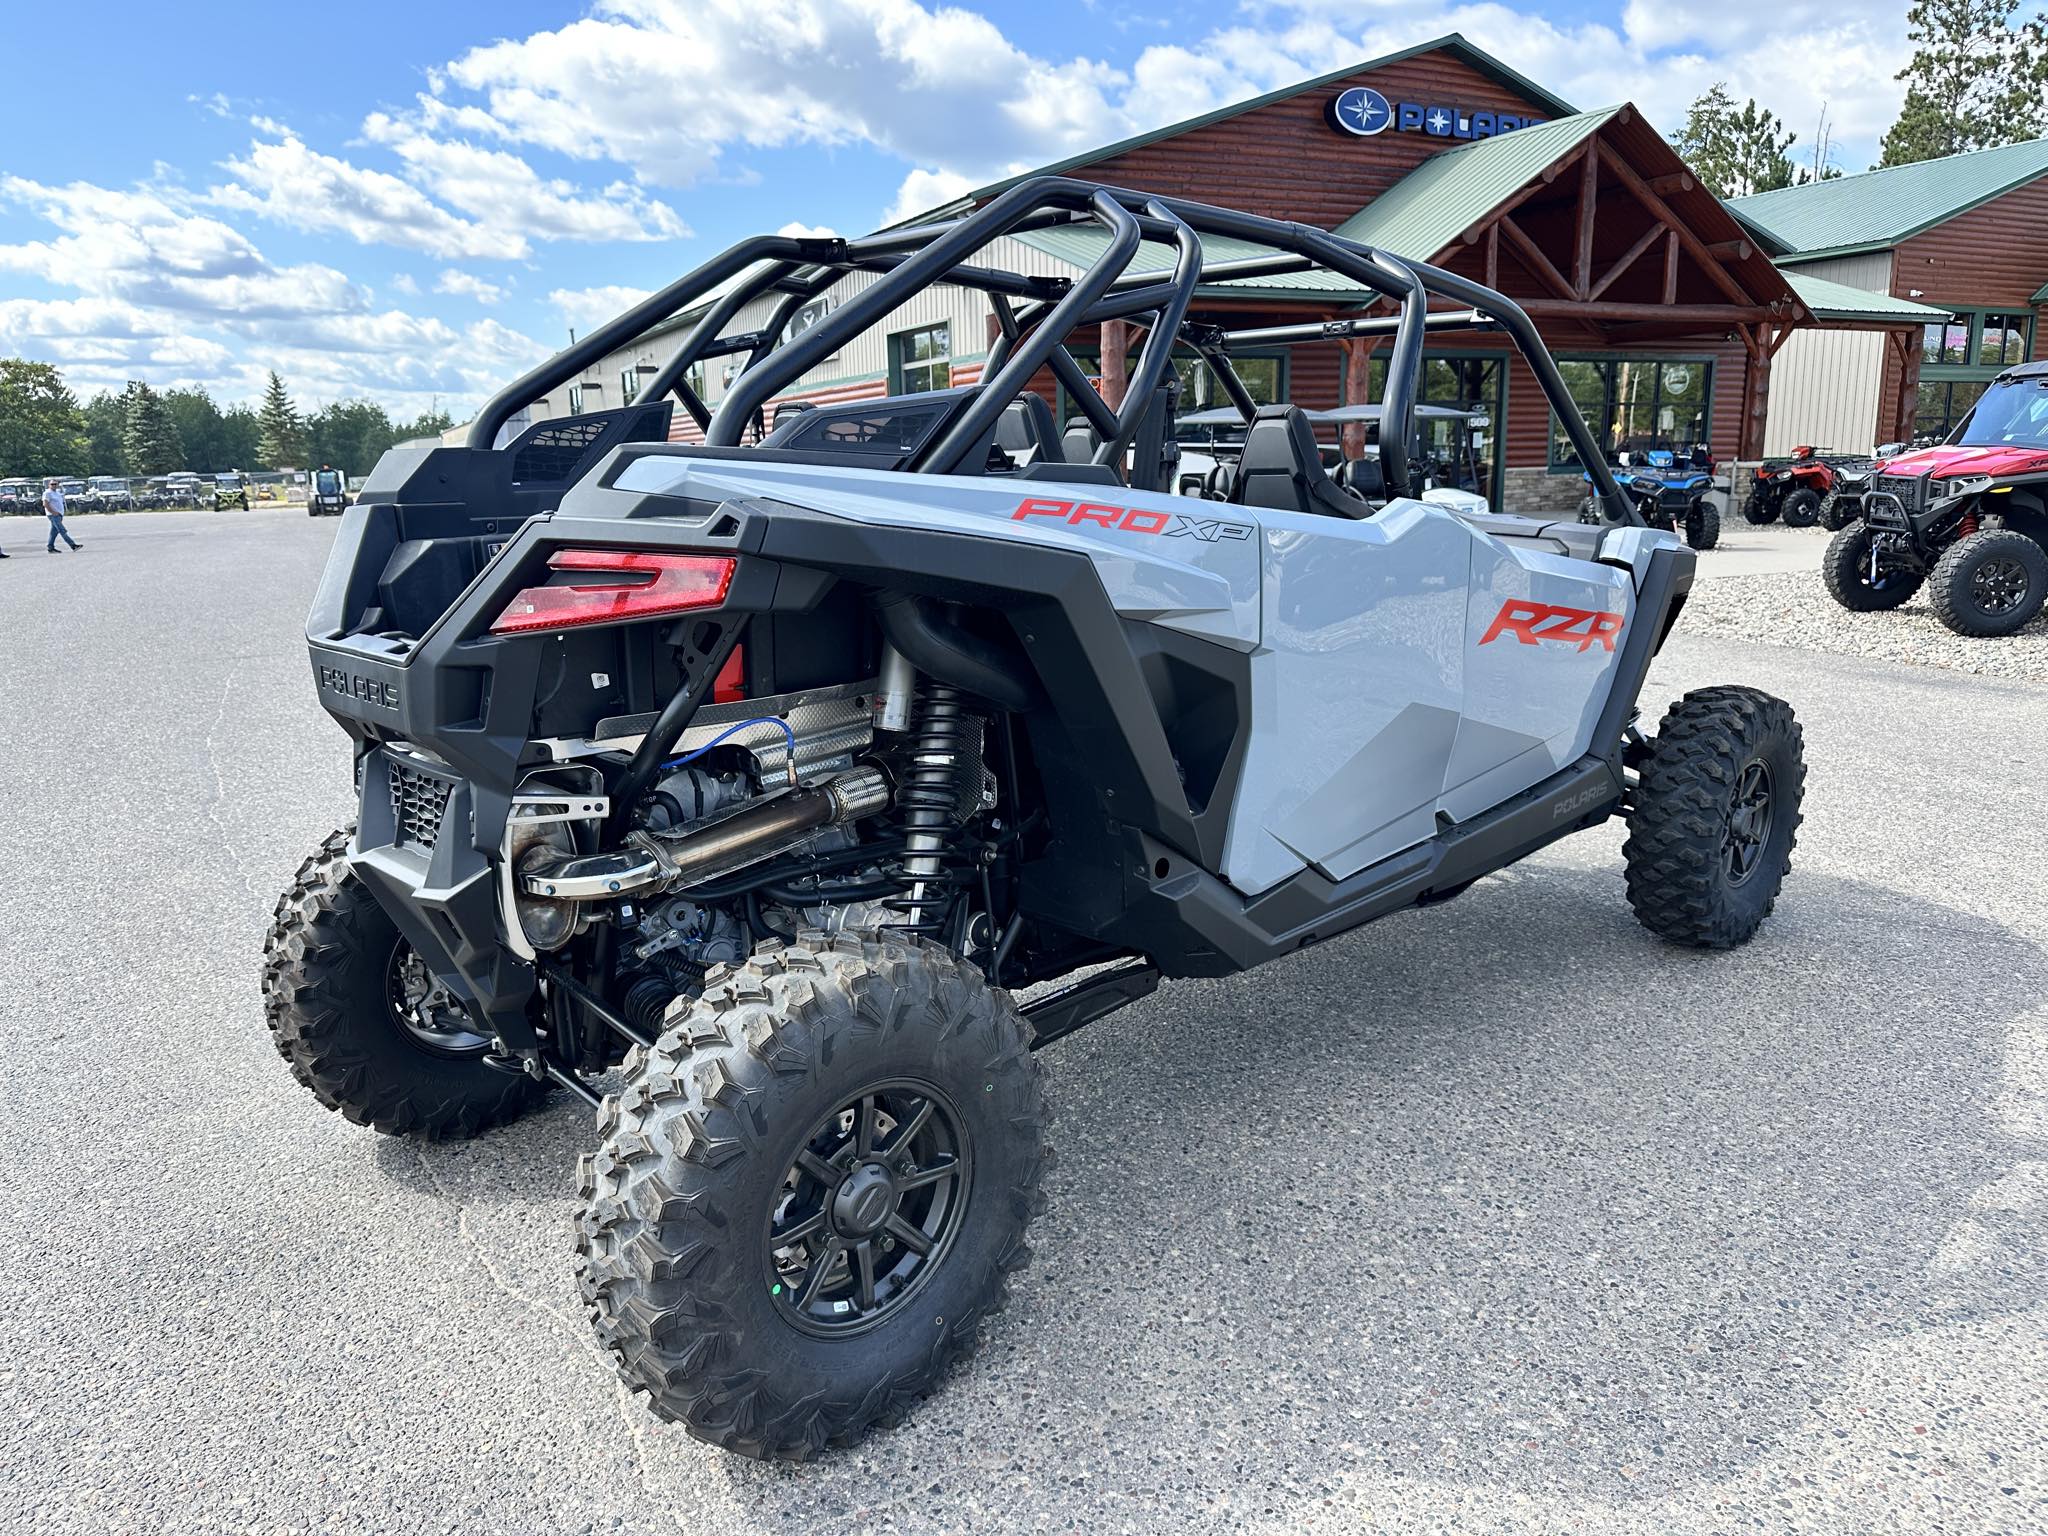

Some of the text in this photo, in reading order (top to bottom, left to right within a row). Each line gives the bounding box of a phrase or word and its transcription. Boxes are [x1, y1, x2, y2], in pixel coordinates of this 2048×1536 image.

[1398, 103, 1548, 140] POLAR
[1011, 498, 1255, 542] PRO XP
[1478, 598, 1624, 654] RZR
[320, 664, 400, 711] POLARIS
[1553, 781, 1609, 819] POLARIS
